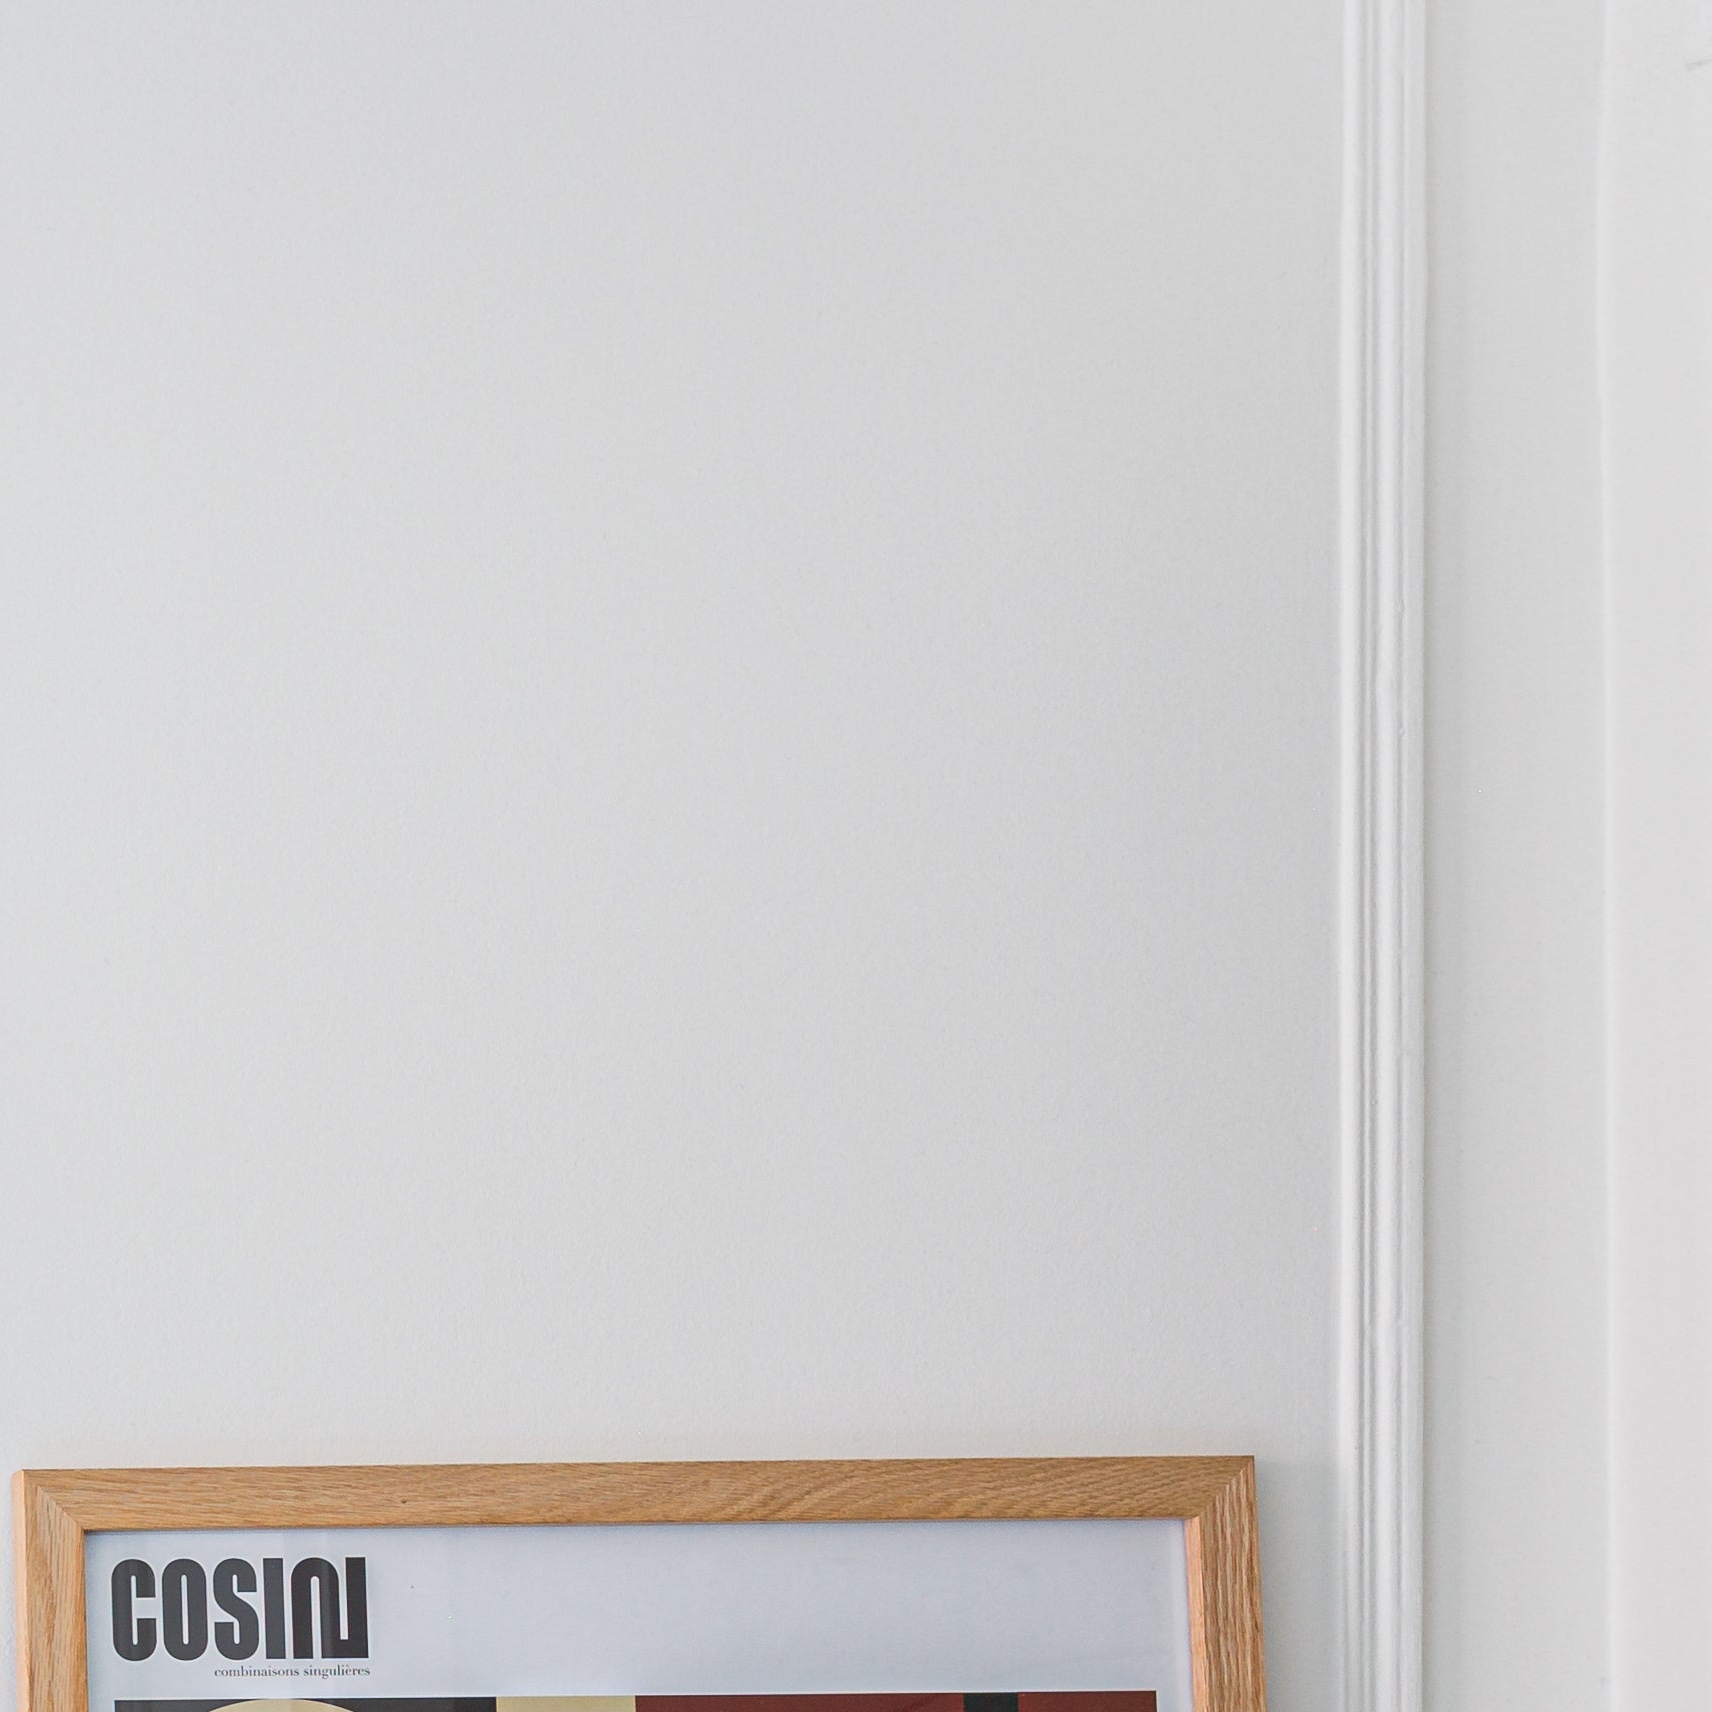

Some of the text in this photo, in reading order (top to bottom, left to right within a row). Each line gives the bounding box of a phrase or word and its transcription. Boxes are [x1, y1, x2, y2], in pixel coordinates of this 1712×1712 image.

[111, 1556, 369, 1662] COSIN
[213, 1664, 371, 1680] combinaisons singulières
